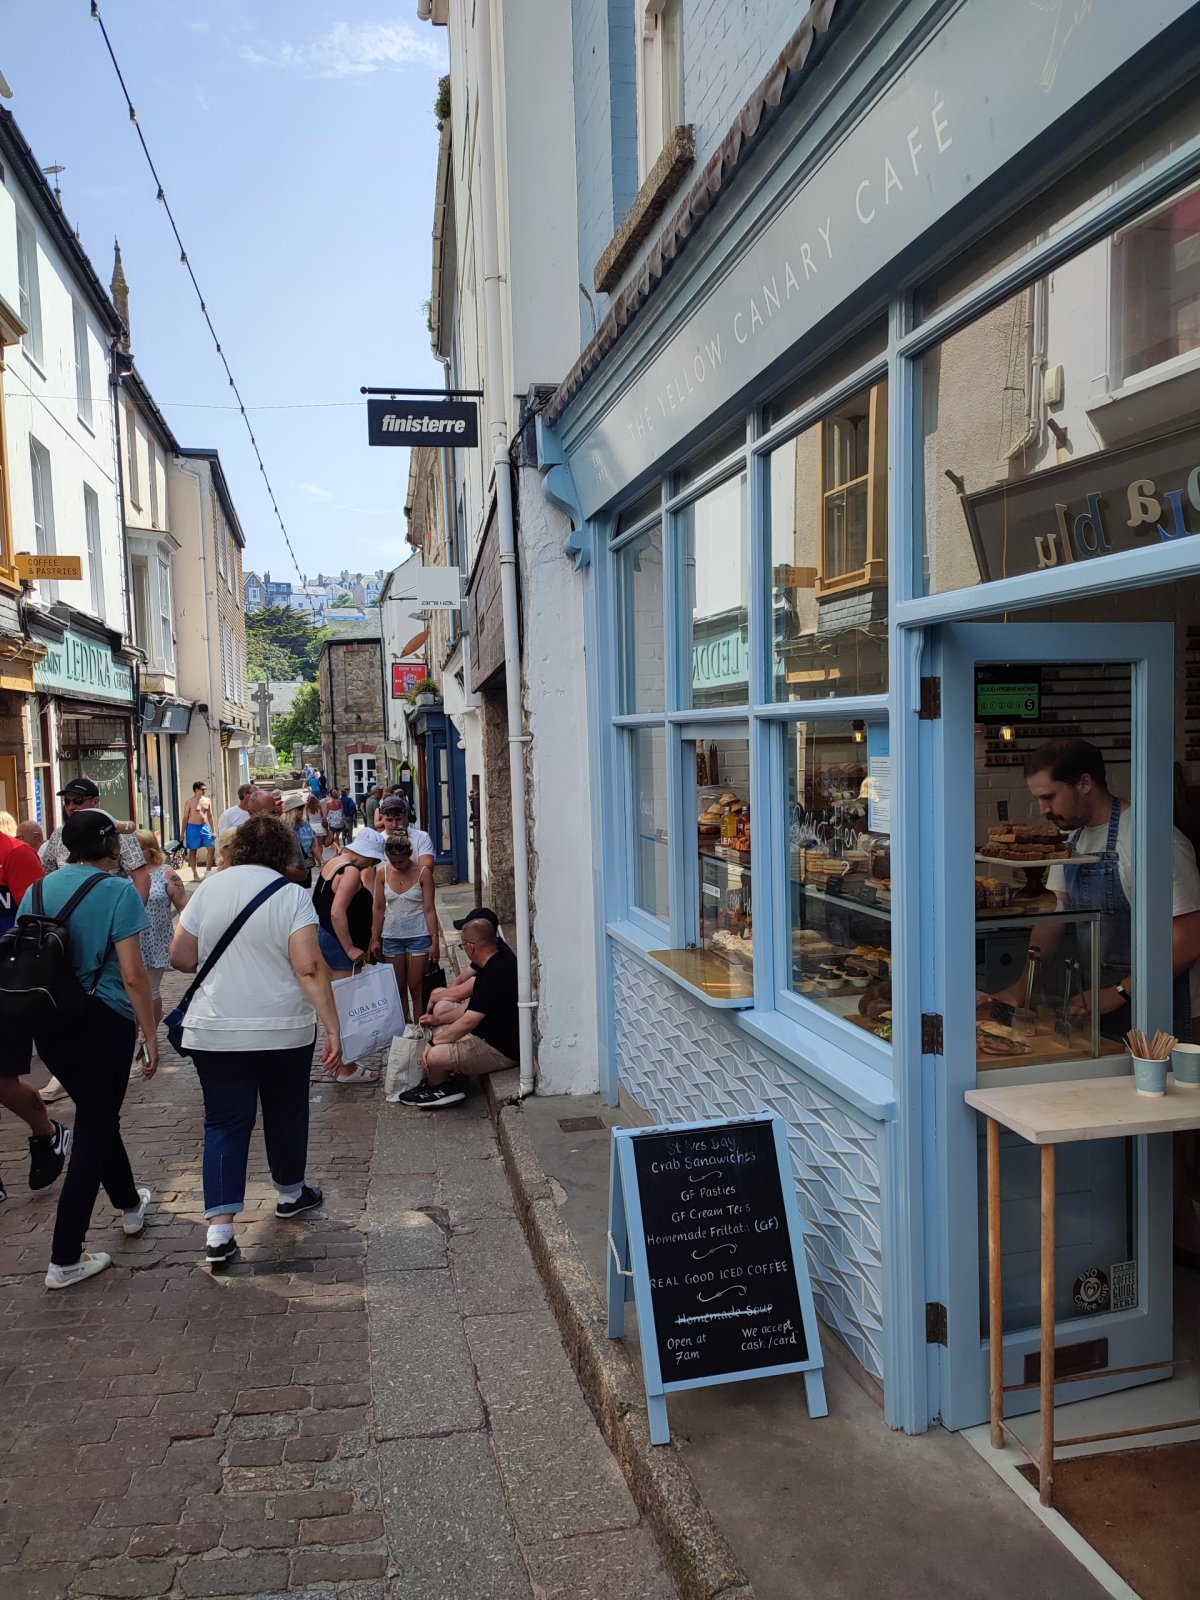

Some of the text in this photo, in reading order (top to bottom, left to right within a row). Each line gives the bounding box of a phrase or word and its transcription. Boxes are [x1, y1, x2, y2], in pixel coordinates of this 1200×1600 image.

[657, 334, 722, 417] YELLOW
[733, 217, 833, 344] CANARY
[856, 89, 953, 224] CAFÉ
[382, 415, 466, 433] finisterre
[28, 559, 59, 567] COFFEE
[36, 567, 77, 575] PASTRIES
[65, 637, 111, 688] LEDDRA
[1026, 700, 1033, 710] 5
[348, 1004, 370, 1017] QUBA
[651, 1158, 681, 1174] Crab
[681, 1184, 736, 1201] GF Pasties
[671, 1211, 686, 1223] GF
[689, 1206, 725, 1219] Cream
[647, 1216, 779, 1246] Homemade Frittat (GF)
[650, 1260, 788, 1289] REAL GOOD ICED COFFEE
[1078, 1268, 1098, 1282] BYO
[1112, 1272, 1136, 1286] COFFEE
[1074, 1284, 1109, 1311] Coffee Cup
[1112, 1283, 1136, 1299] GUIDE
[1113, 1297, 1136, 1309] HERE
[741, 1318, 794, 1338] We accept
[666, 1333, 707, 1350] Open at
[675, 1350, 701, 1365] 7am
